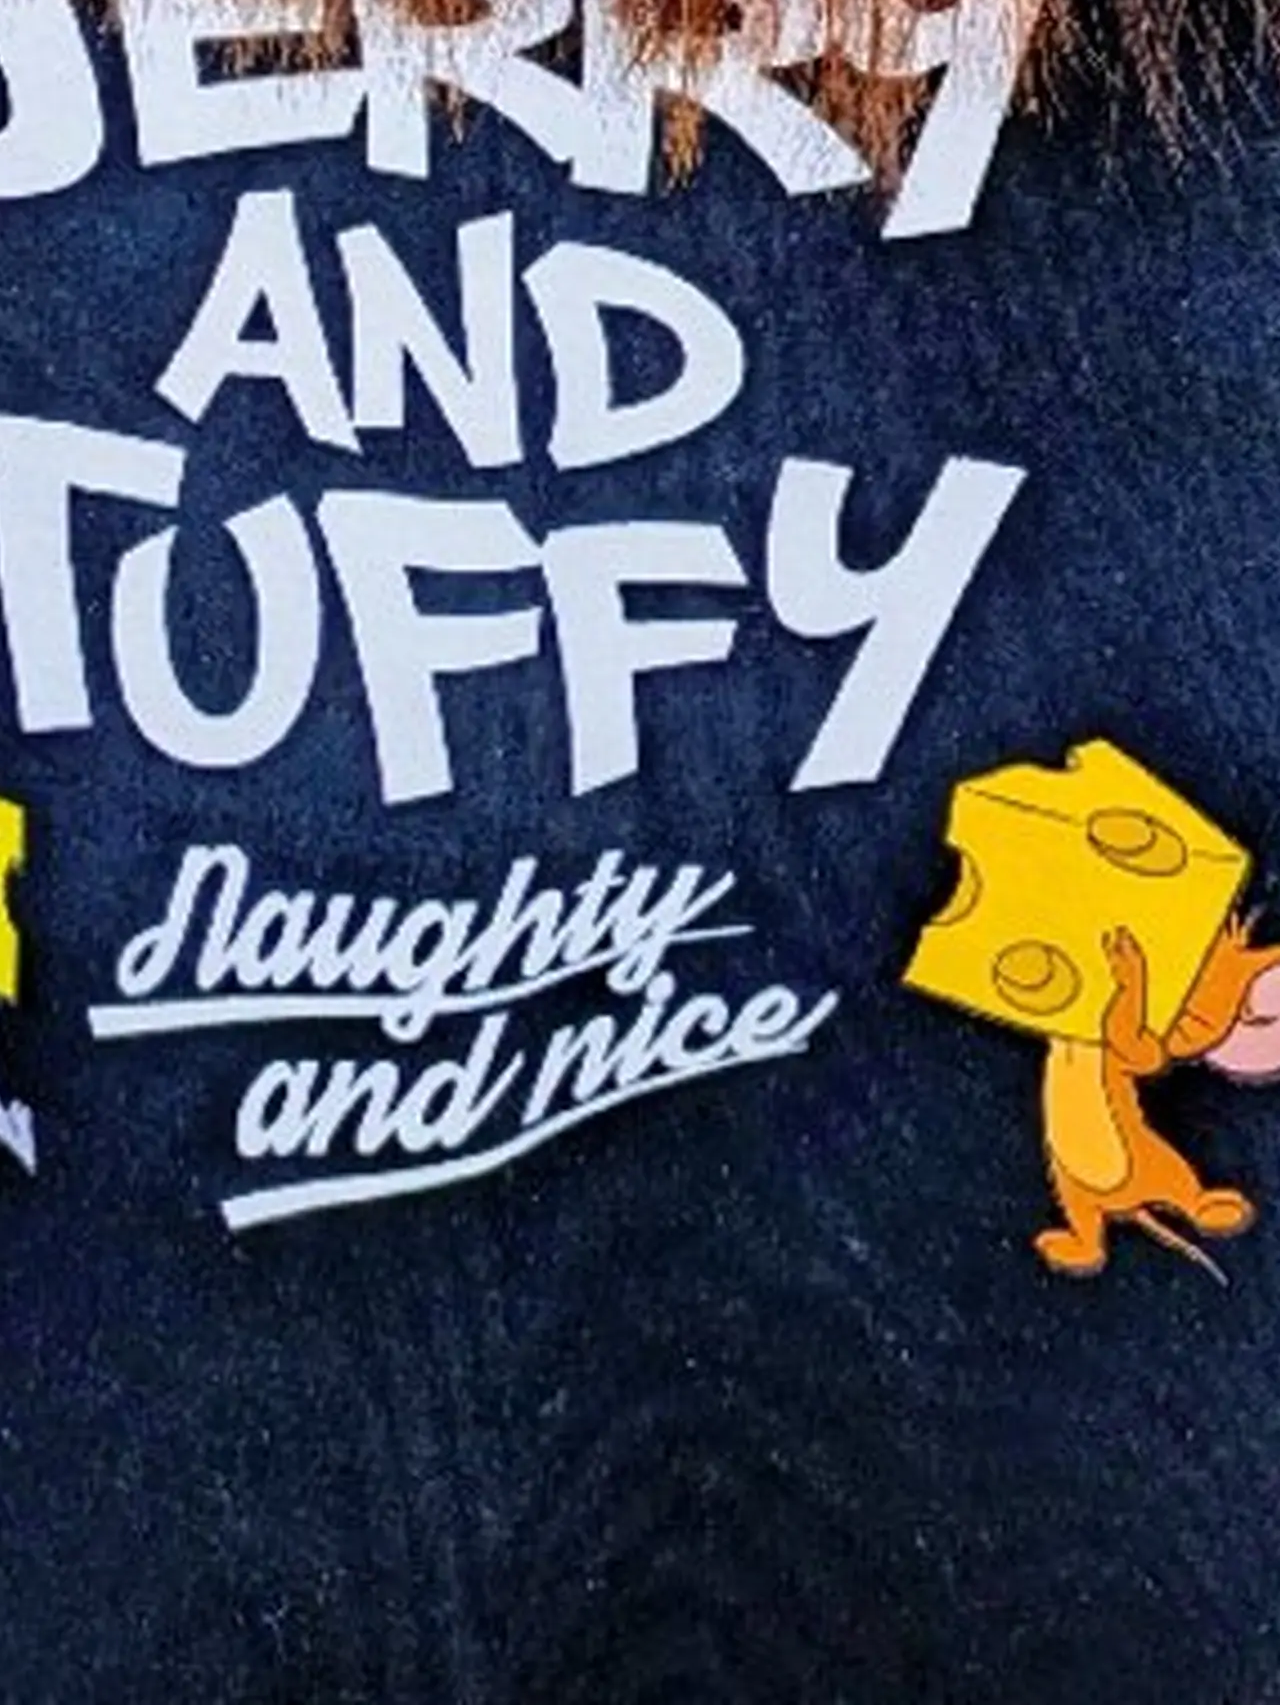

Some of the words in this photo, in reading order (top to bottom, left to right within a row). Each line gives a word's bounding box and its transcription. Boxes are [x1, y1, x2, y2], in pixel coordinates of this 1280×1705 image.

[156, 189, 745, 471] AND
[117, 844, 734, 1041] Naughty
[234, 1012, 523, 1158] and
[523, 971, 839, 1124] nice
